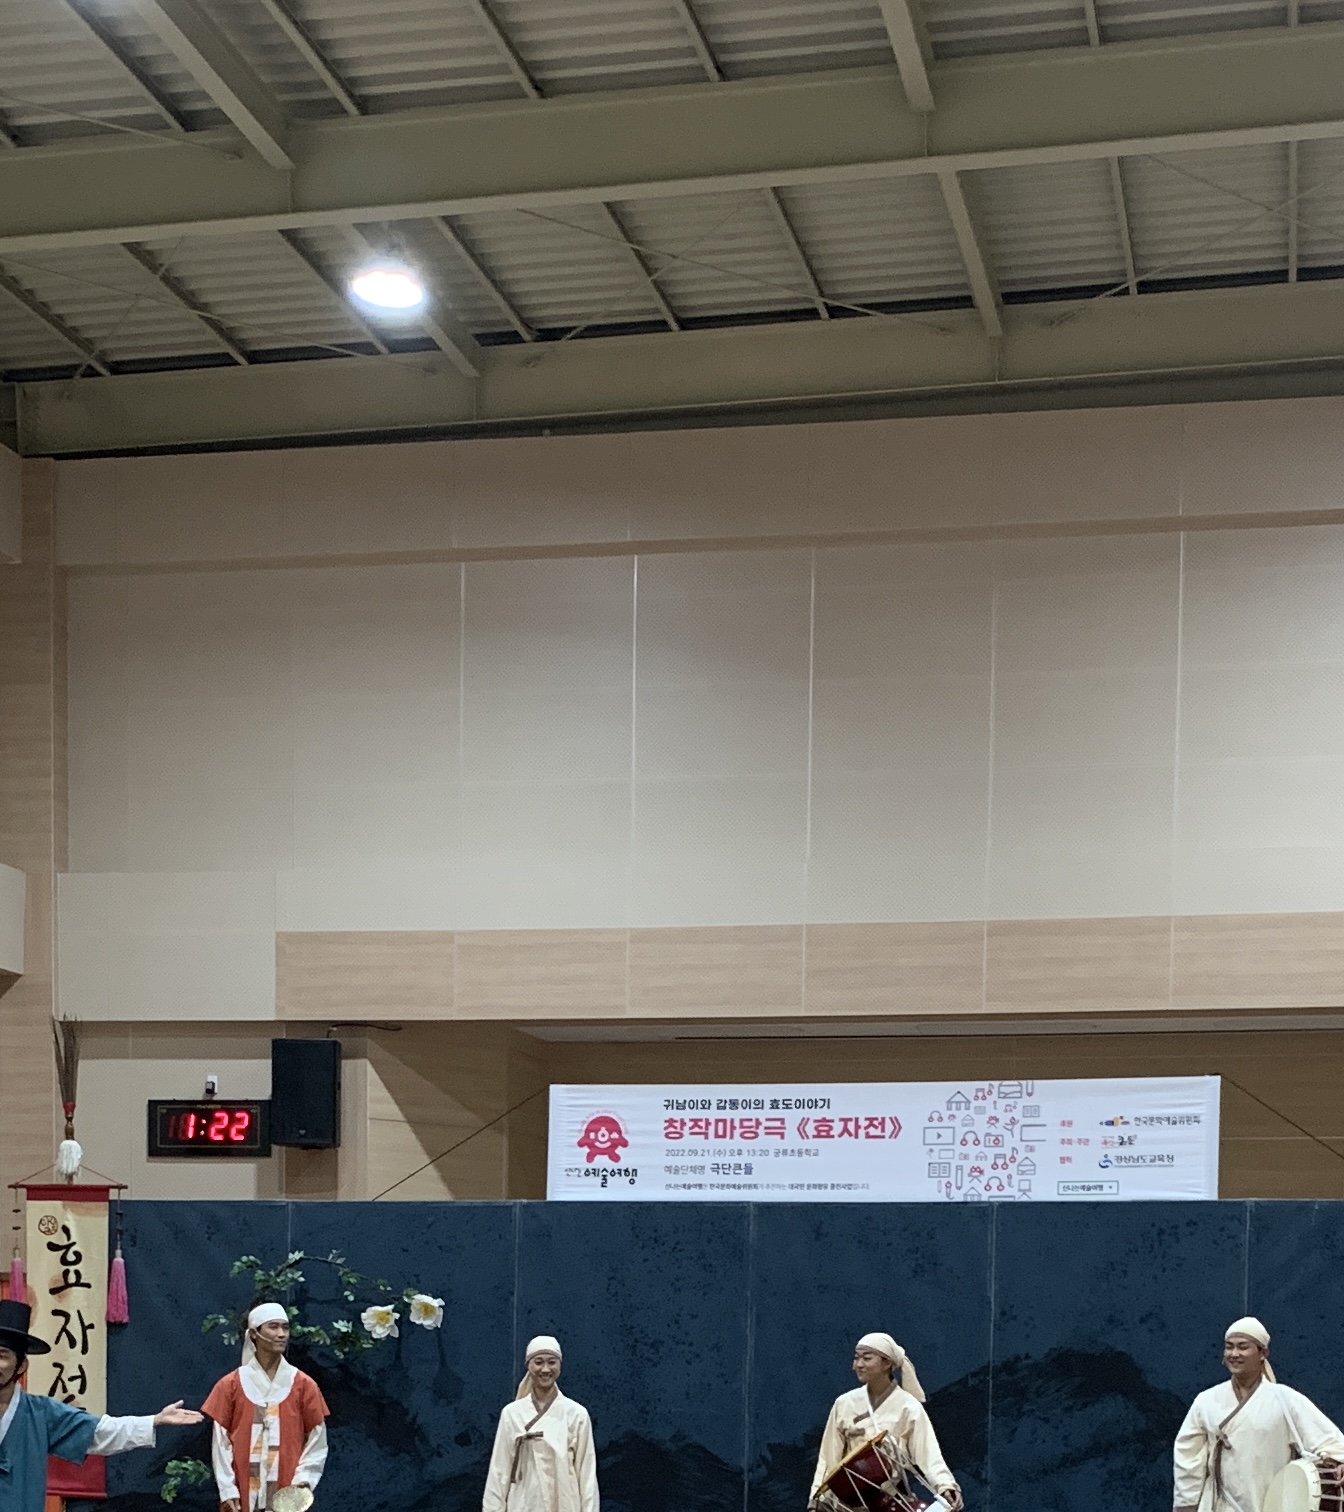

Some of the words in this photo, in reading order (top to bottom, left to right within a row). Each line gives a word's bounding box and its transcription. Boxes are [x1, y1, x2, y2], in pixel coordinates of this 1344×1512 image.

[769, 1098, 831, 1110] 효도이야기
[187, 1111, 250, 1141] 1:22
[663, 1117, 787, 1140] 창작마당극
[709, 1162, 754, 1175] 극단큰들
